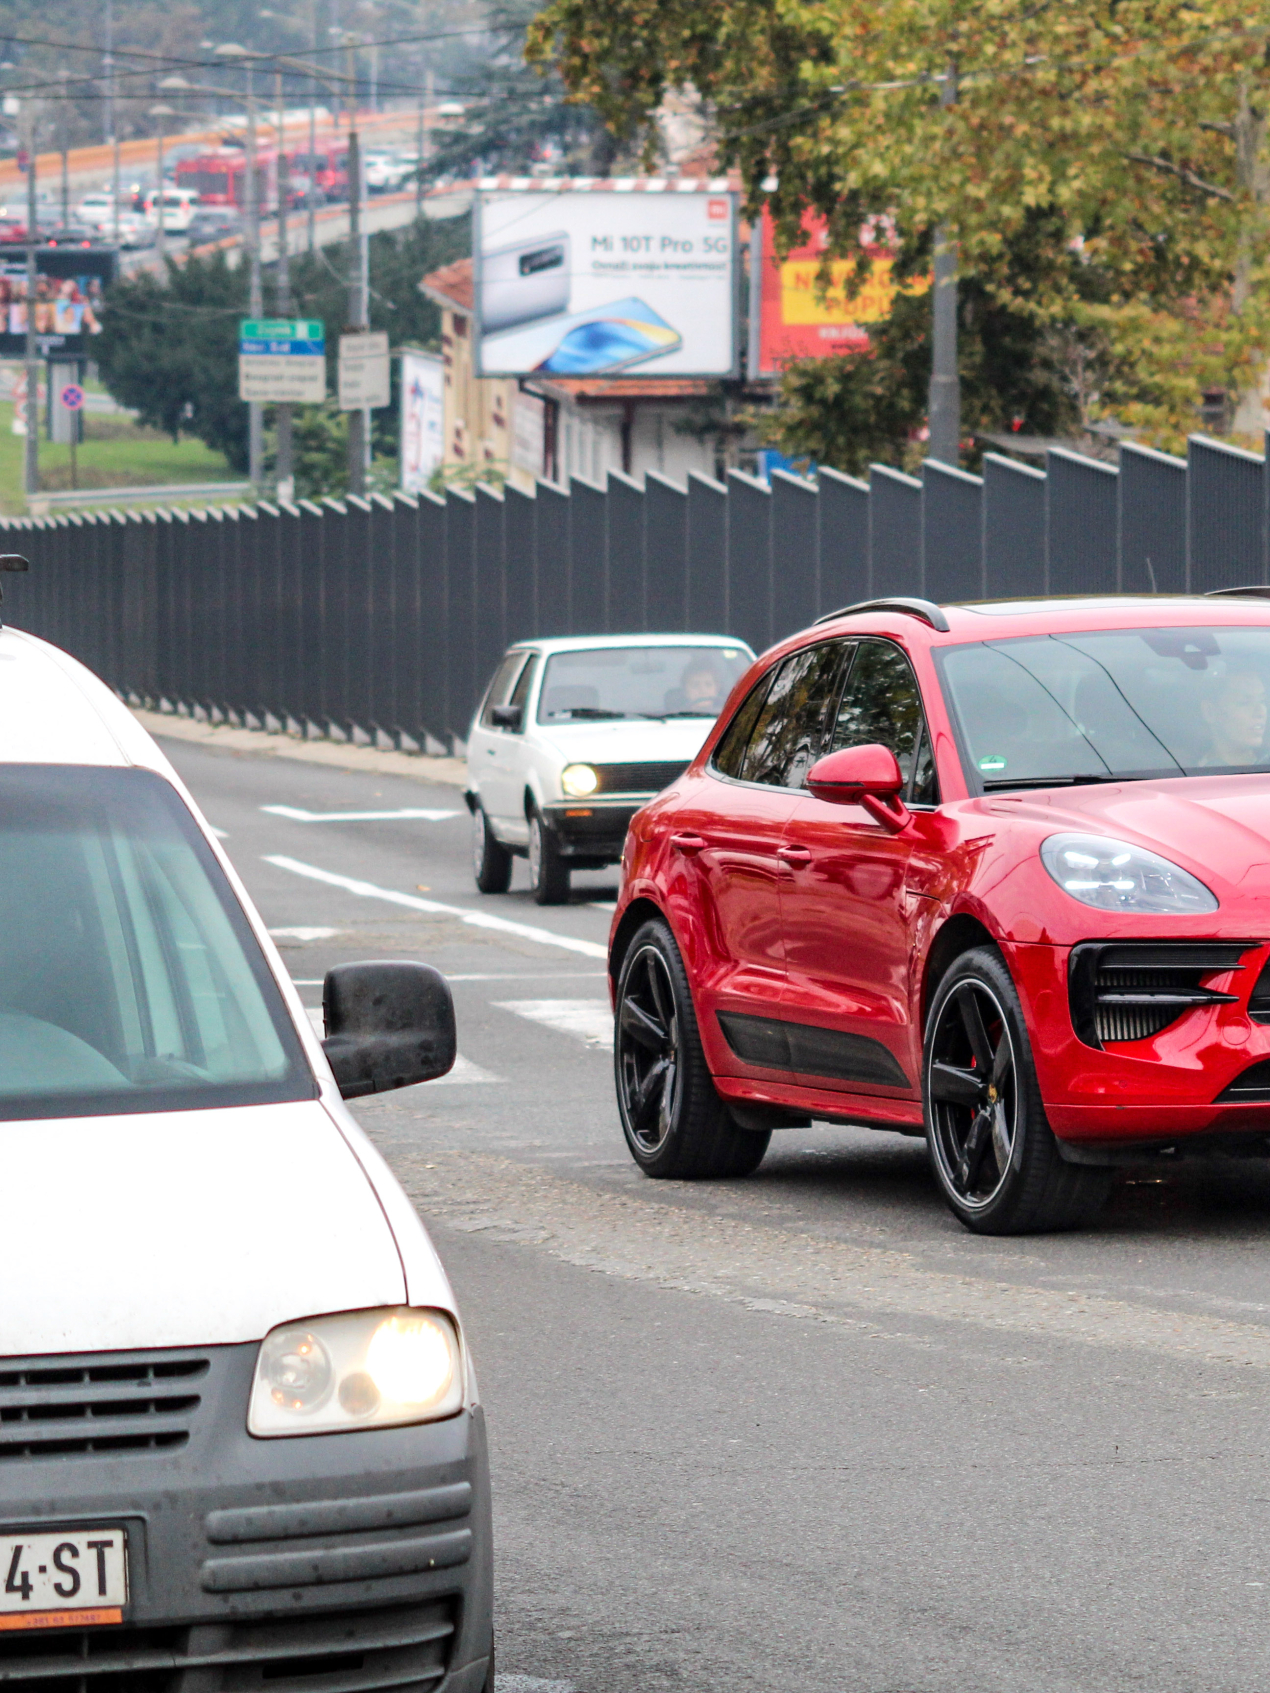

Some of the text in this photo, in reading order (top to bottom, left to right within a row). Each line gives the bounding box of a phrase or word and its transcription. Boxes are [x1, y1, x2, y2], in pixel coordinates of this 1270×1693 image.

[591, 236, 728, 253] Mi 10T Pro 5G
